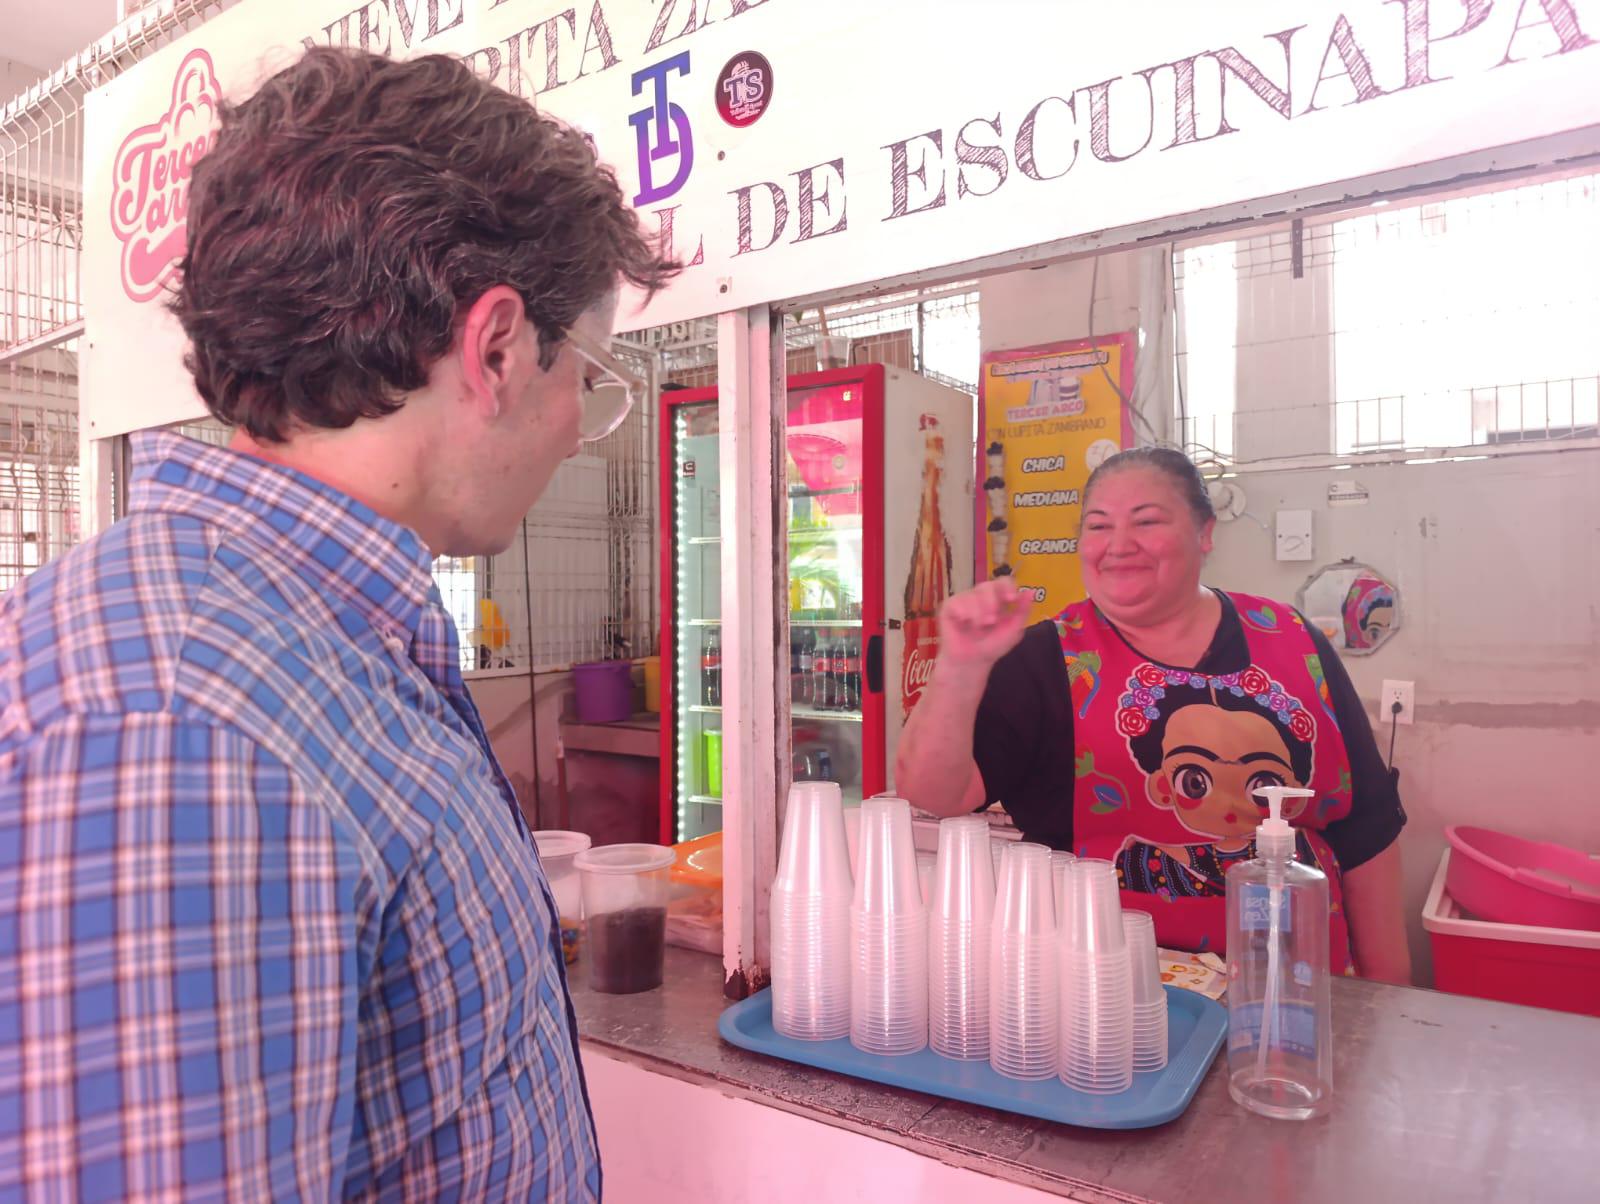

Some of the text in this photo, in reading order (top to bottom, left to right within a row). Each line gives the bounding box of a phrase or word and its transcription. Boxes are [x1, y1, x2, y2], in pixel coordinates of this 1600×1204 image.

[724, 69, 764, 109] TS
[727, 157, 847, 258] DE
[880, 0, 1600, 222] ESCUINAPA
[146, 187, 188, 233] ar
[1052, 400, 1083, 415] ARCO
[1022, 456, 1065, 473] CHICA
[1014, 489, 1079, 508] MEDIANA
[1020, 539, 1077, 555] GRANDE
[904, 649, 936, 697] Coca
